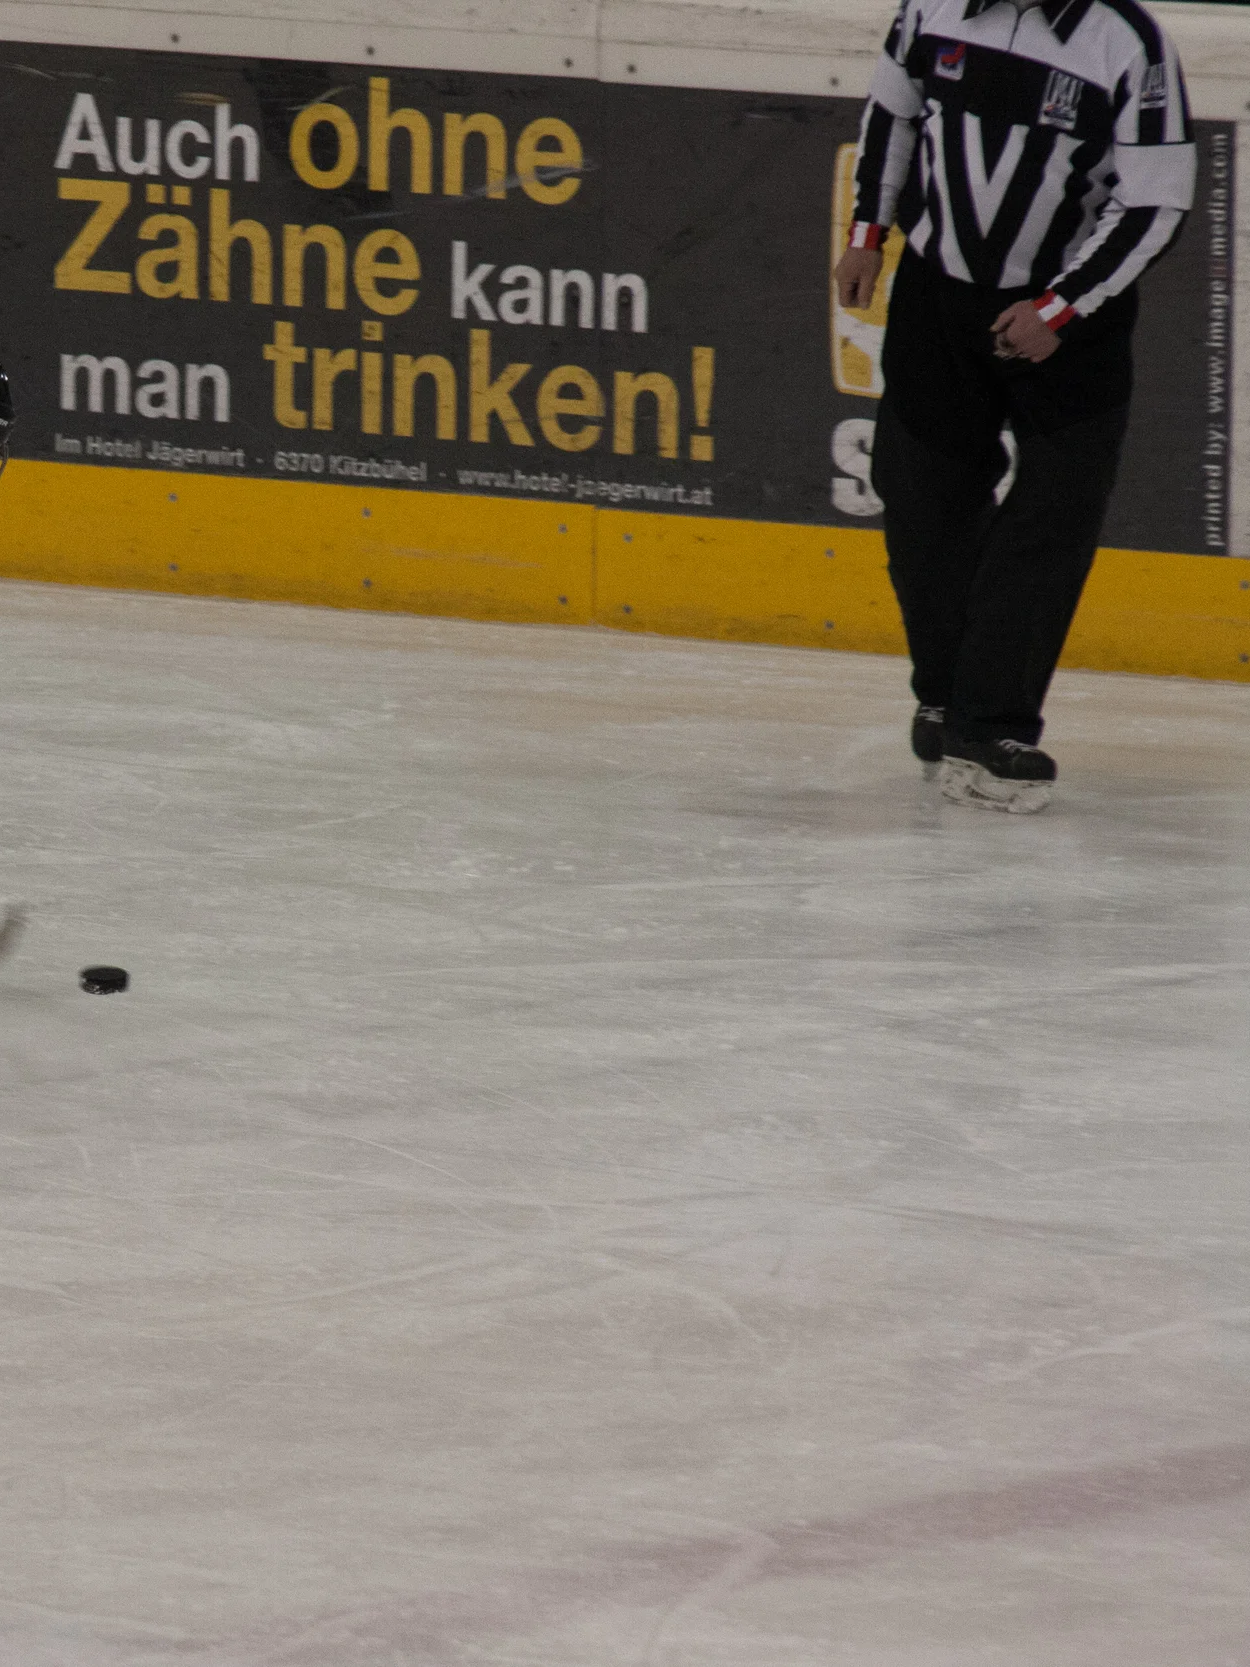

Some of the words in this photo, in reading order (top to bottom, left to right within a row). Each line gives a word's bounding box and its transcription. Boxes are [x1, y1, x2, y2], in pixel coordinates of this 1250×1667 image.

[53, 92, 261, 183] Auch
[288, 76, 585, 206] ohne
[53, 176, 422, 316] Zähne
[450, 240, 650, 334] kann
[58, 352, 232, 424] man
[262, 320, 715, 462] trinken!
[86, 435, 141, 458] Hotel
[146, 440, 246, 468] Jägerwirt
[273, 450, 325, 473] 6370
[329, 454, 428, 482] Kitzbühel
[1201, 463, 1226, 548] printed
